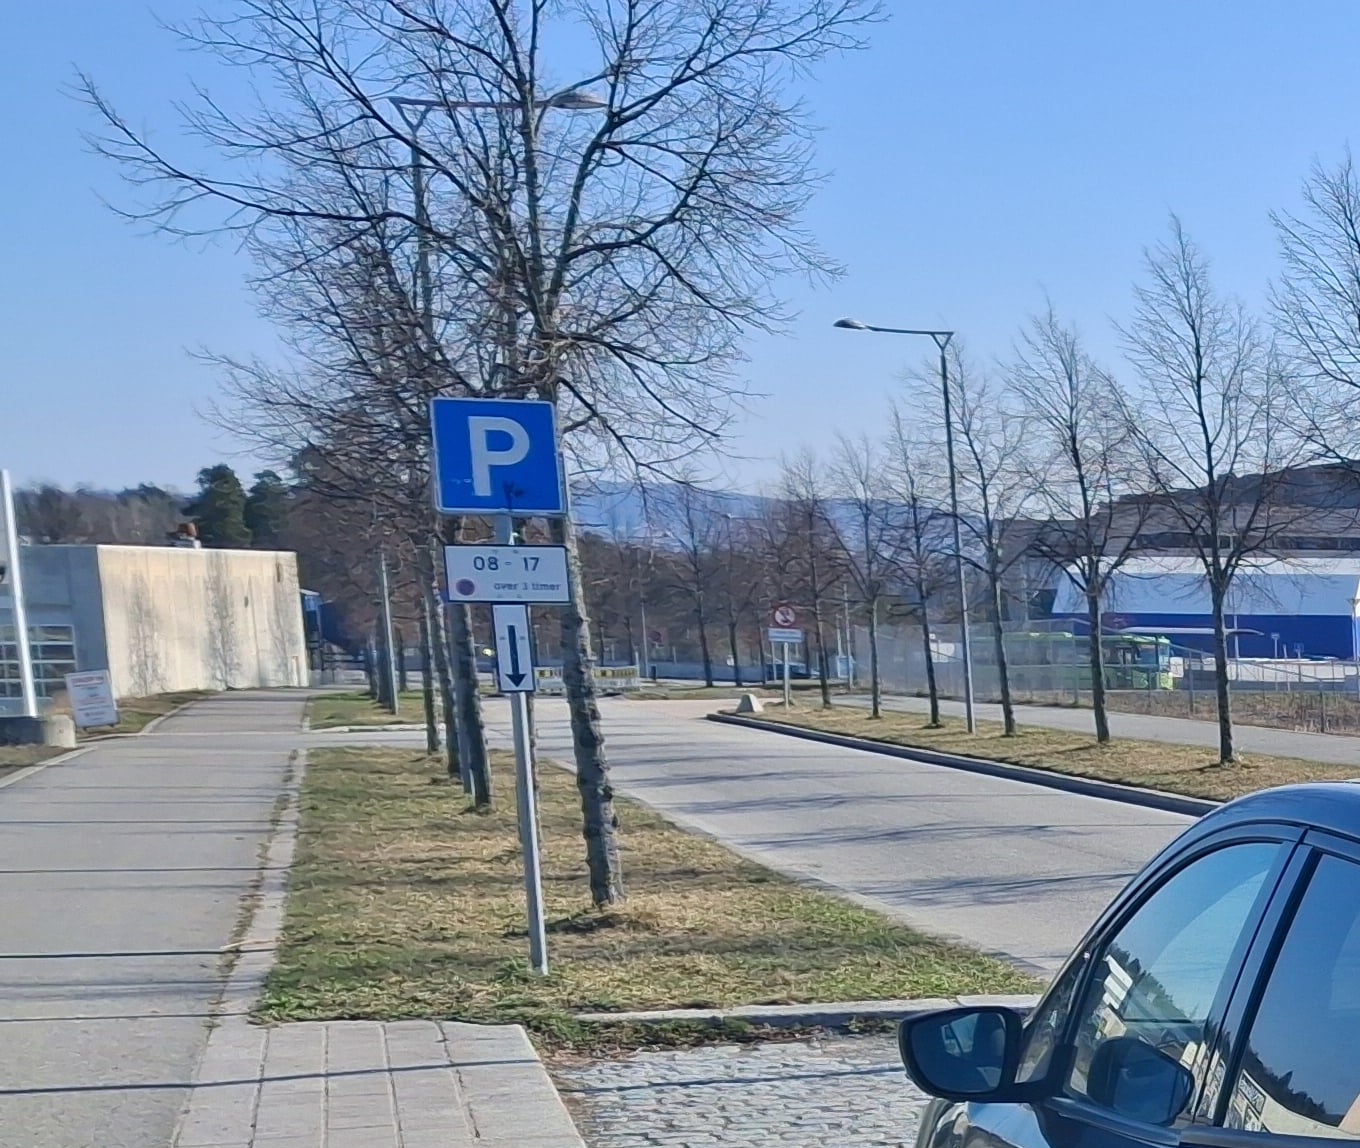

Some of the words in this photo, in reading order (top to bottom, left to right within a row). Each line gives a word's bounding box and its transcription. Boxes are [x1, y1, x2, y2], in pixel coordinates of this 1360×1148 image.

[467, 415, 530, 497] P
[473, 556, 499, 571] 08
[523, 557, 540, 571] 17
[494, 583, 518, 591] over
[532, 582, 561, 591] timer
